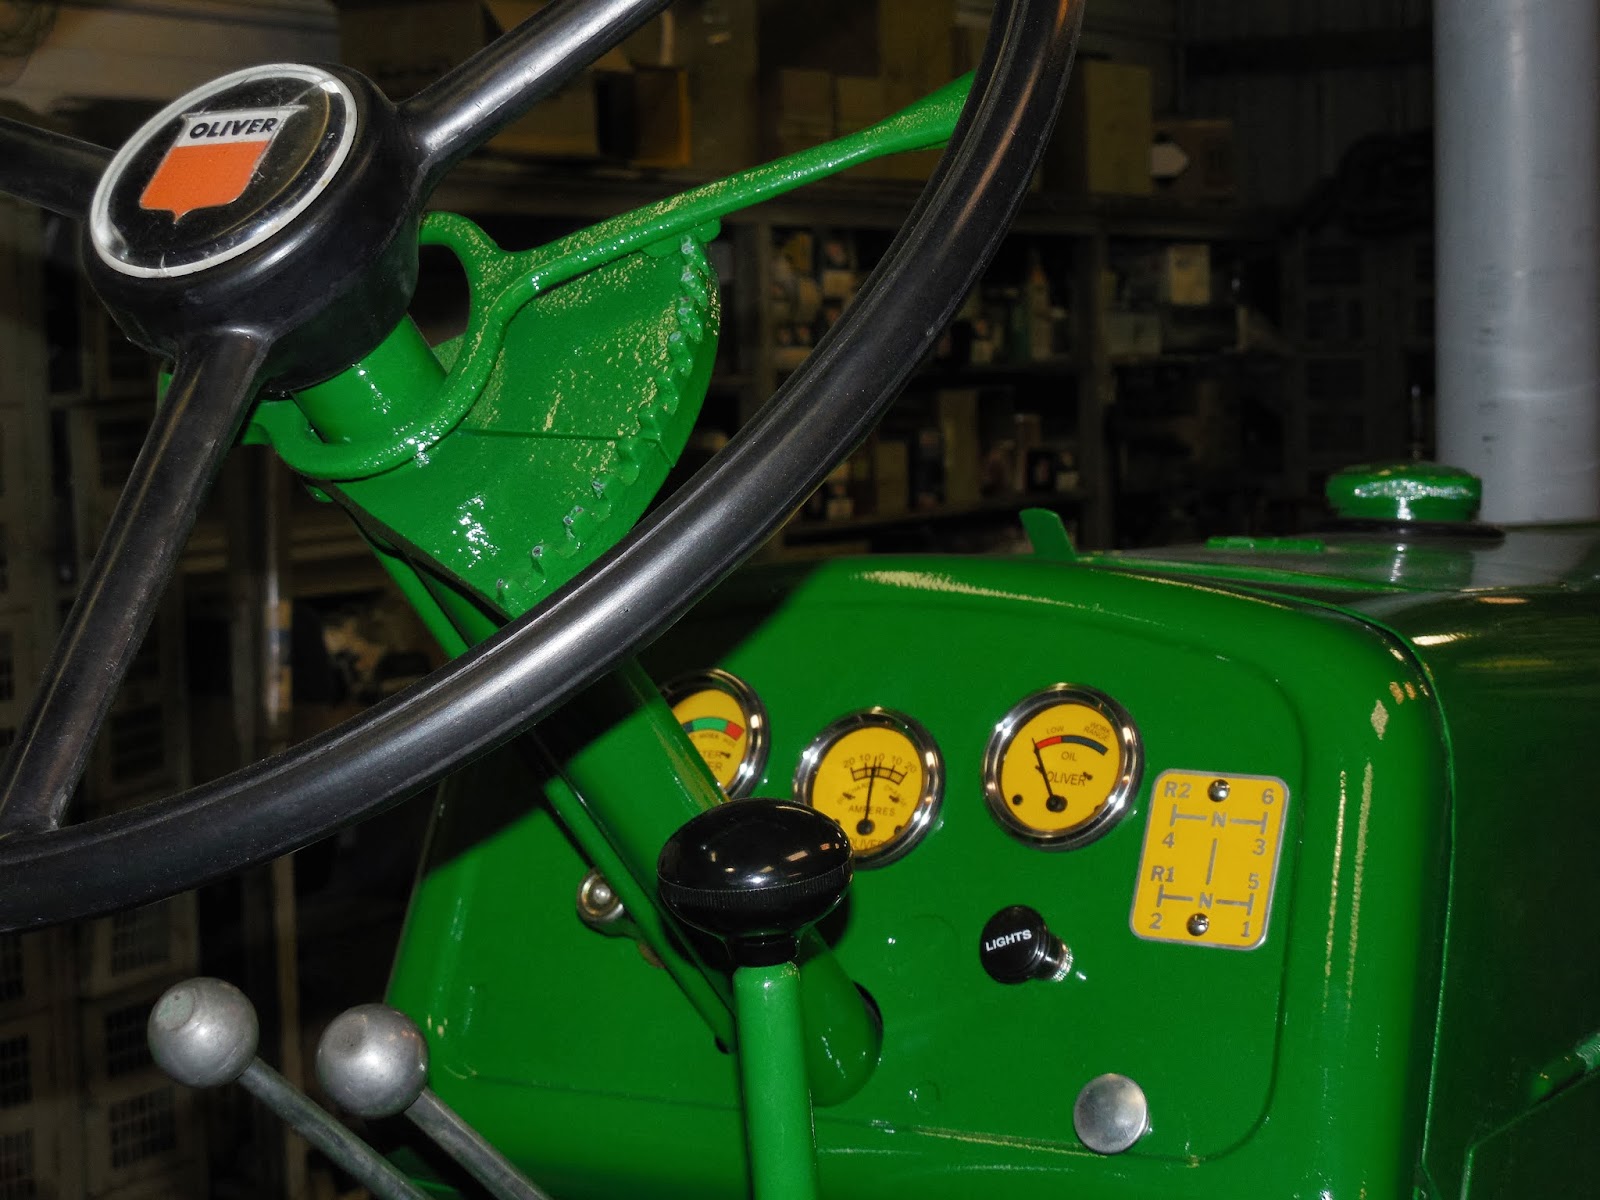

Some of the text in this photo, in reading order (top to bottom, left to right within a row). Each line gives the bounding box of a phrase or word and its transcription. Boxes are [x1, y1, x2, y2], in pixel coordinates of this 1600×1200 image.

[189, 117, 279, 140] OLIVER
[1046, 725, 1065, 736] LOW
[1083, 726, 1108, 742] RANGE
[1090, 721, 1111, 734] WORK
[843, 756, 856, 769] 20
[859, 753, 871, 762] 10
[892, 755, 903, 765] 10
[904, 761, 917, 774] 20
[1061, 751, 1078, 762] OIL
[1046, 771, 1086, 787] OLIVER
[1164, 781, 1192, 799] R2
[1262, 788, 1275, 805] 6
[1211, 811, 1228, 828] N
[1162, 832, 1175, 849] 4
[1252, 838, 1266, 856] 3
[1150, 865, 1175, 883] R1
[1248, 873, 1260, 890] 5
[1198, 892, 1214, 909] N
[1149, 912, 1163, 930] 2
[1241, 921, 1251, 938] 1
[985, 929, 1032, 952] LIGHTS
